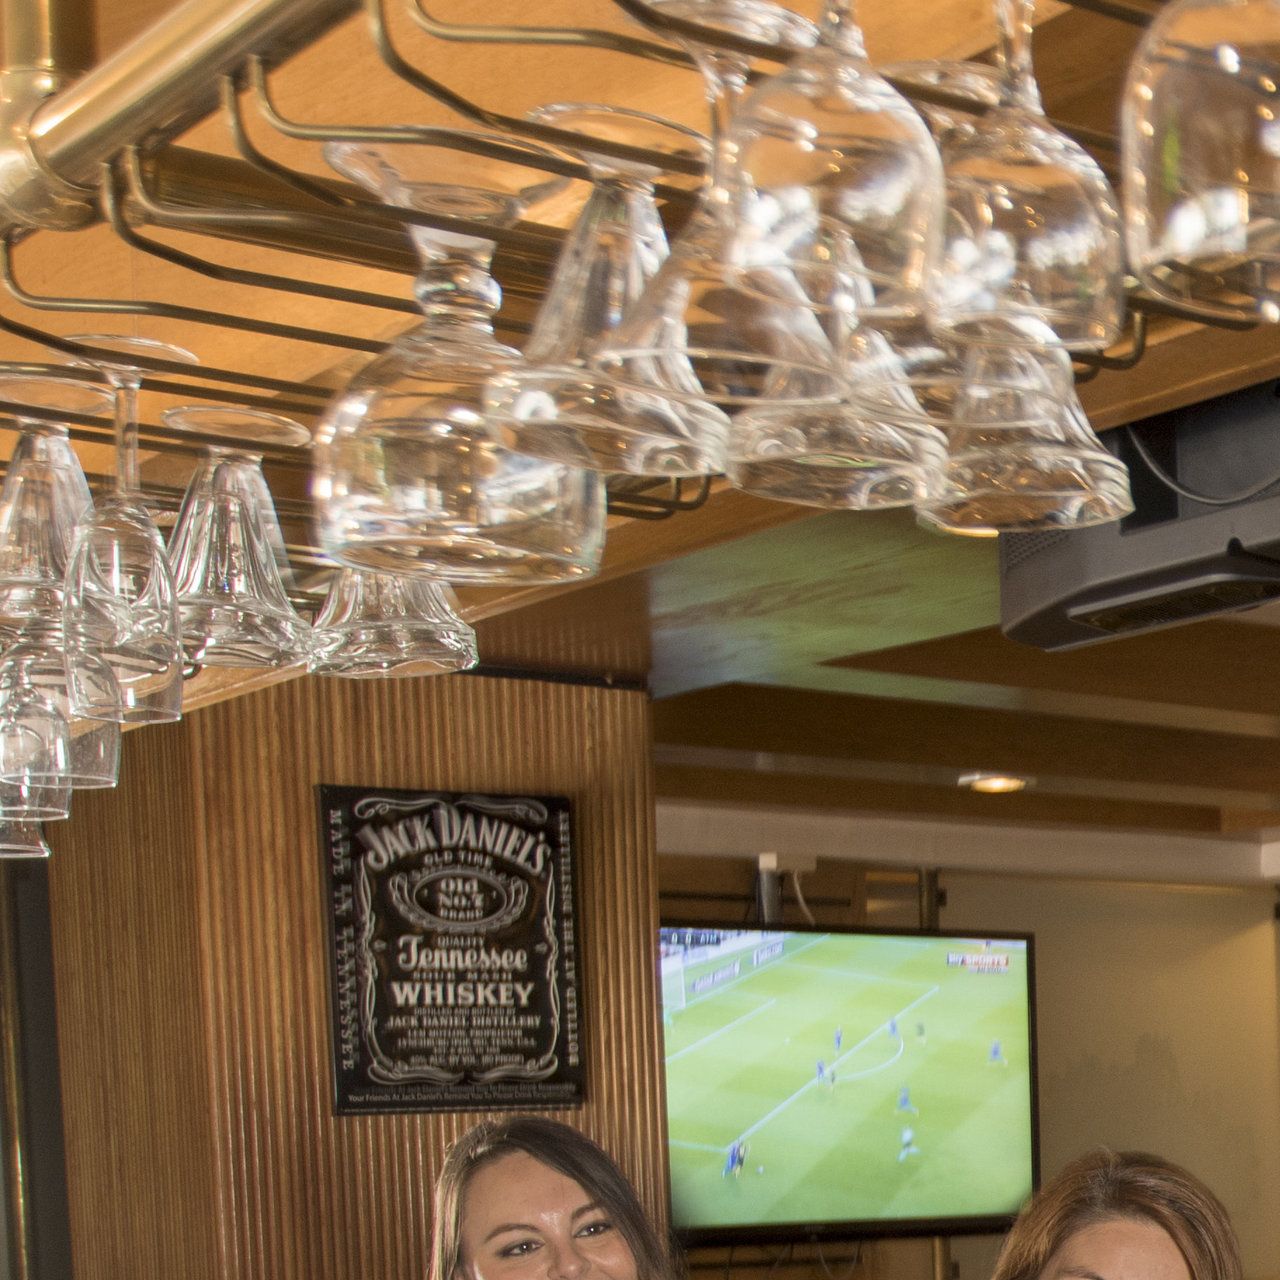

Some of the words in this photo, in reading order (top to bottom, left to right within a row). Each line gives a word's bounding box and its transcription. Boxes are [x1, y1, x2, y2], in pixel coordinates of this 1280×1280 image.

[330, 809, 346, 876] MADE
[355, 813, 439, 871] JACK
[436, 803, 552, 877] DANIEL'S
[424, 850, 453, 866] OLD
[459, 849, 493, 868] TIME
[558, 811, 573, 914] DISTILLERY
[440, 878, 479, 893] Old
[334, 889, 347, 916] IN
[437, 935, 485, 947] QUALITY
[562, 918, 575, 954] THE
[397, 933, 529, 972] Tennessee
[564, 958, 577, 981] AT
[336, 933, 355, 1071] TENNESSEE
[391, 980, 535, 1008] WHISKEY
[389, 1015, 419, 1028] JACK
[422, 1015, 467, 1027] DANIEL
[565, 987, 579, 1067] BOTTLED
[365, 1093, 391, 1102] Friends
[401, 1093, 416, 1101] Jack
